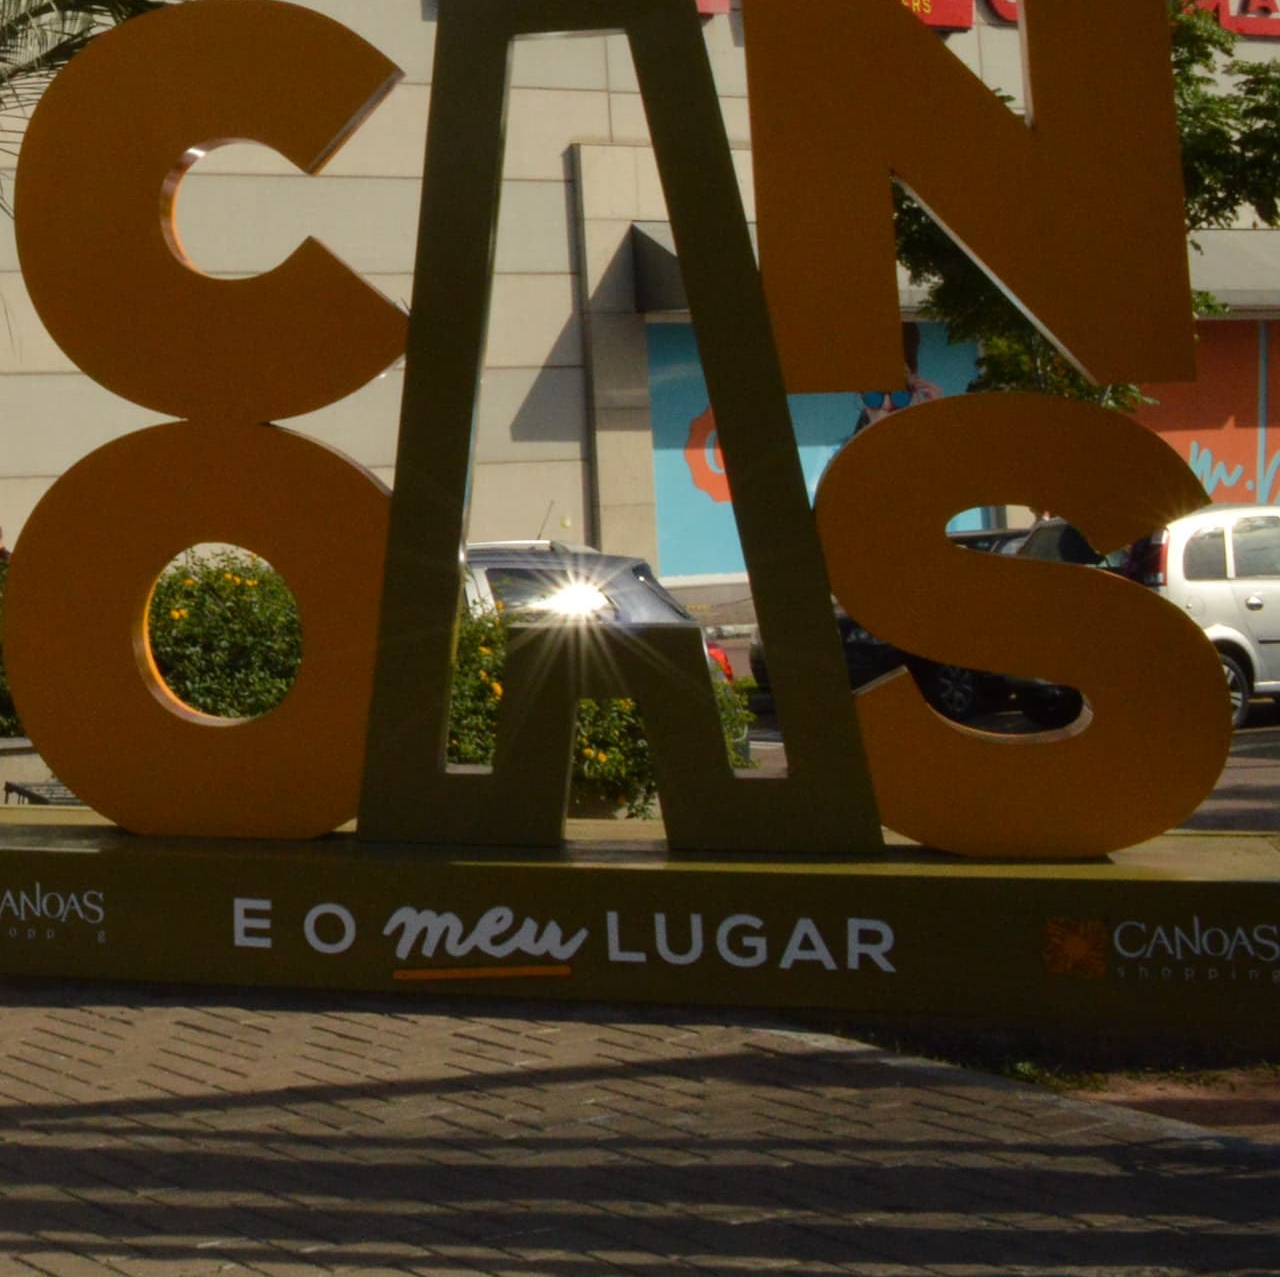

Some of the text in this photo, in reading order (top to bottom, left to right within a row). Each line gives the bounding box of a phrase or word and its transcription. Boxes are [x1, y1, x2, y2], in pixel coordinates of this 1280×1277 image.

[233, 897, 897, 973] E O meu LUGAR
[1113, 915, 1280, 962] CANOAS
